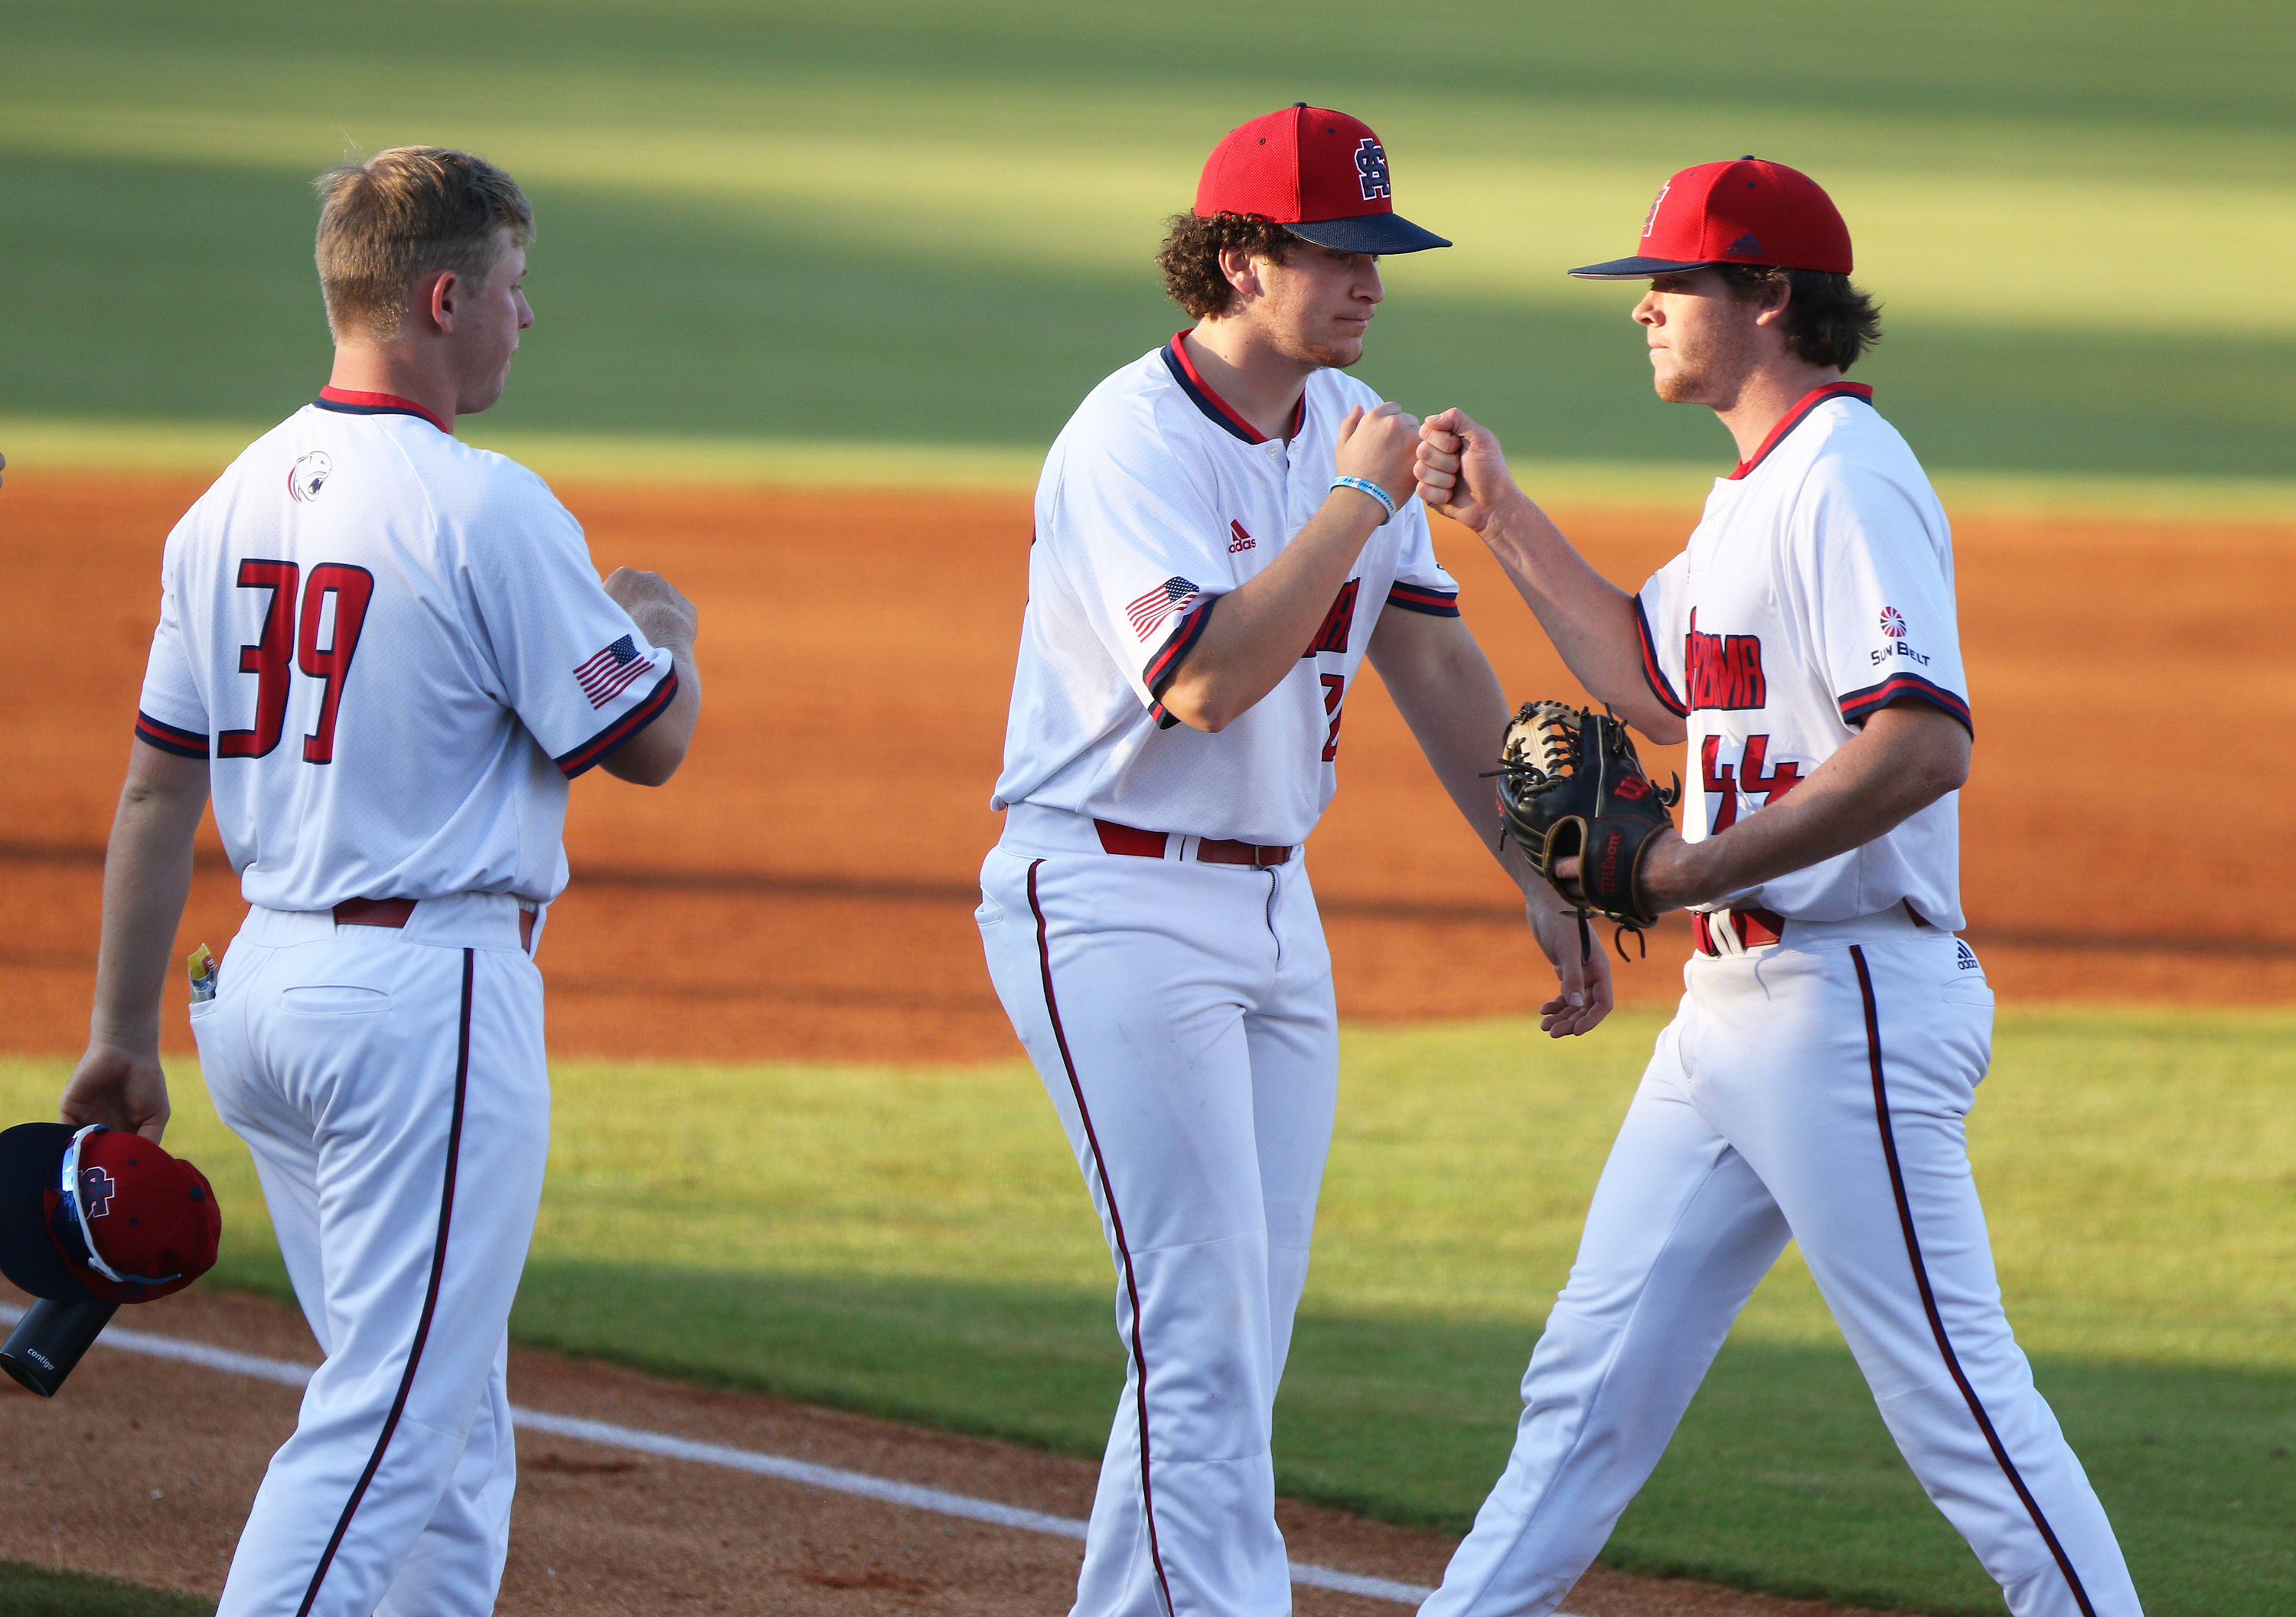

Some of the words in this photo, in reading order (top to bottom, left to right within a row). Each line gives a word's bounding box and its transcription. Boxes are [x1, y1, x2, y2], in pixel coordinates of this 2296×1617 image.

[217, 558, 374, 764] 39
[1870, 644, 1893, 667] SUN
[1896, 641, 1930, 667] BELT
[1701, 734, 1805, 836] 44
[1600, 830, 1622, 895] Wilson
[27, 1348, 54, 1371] contigo
